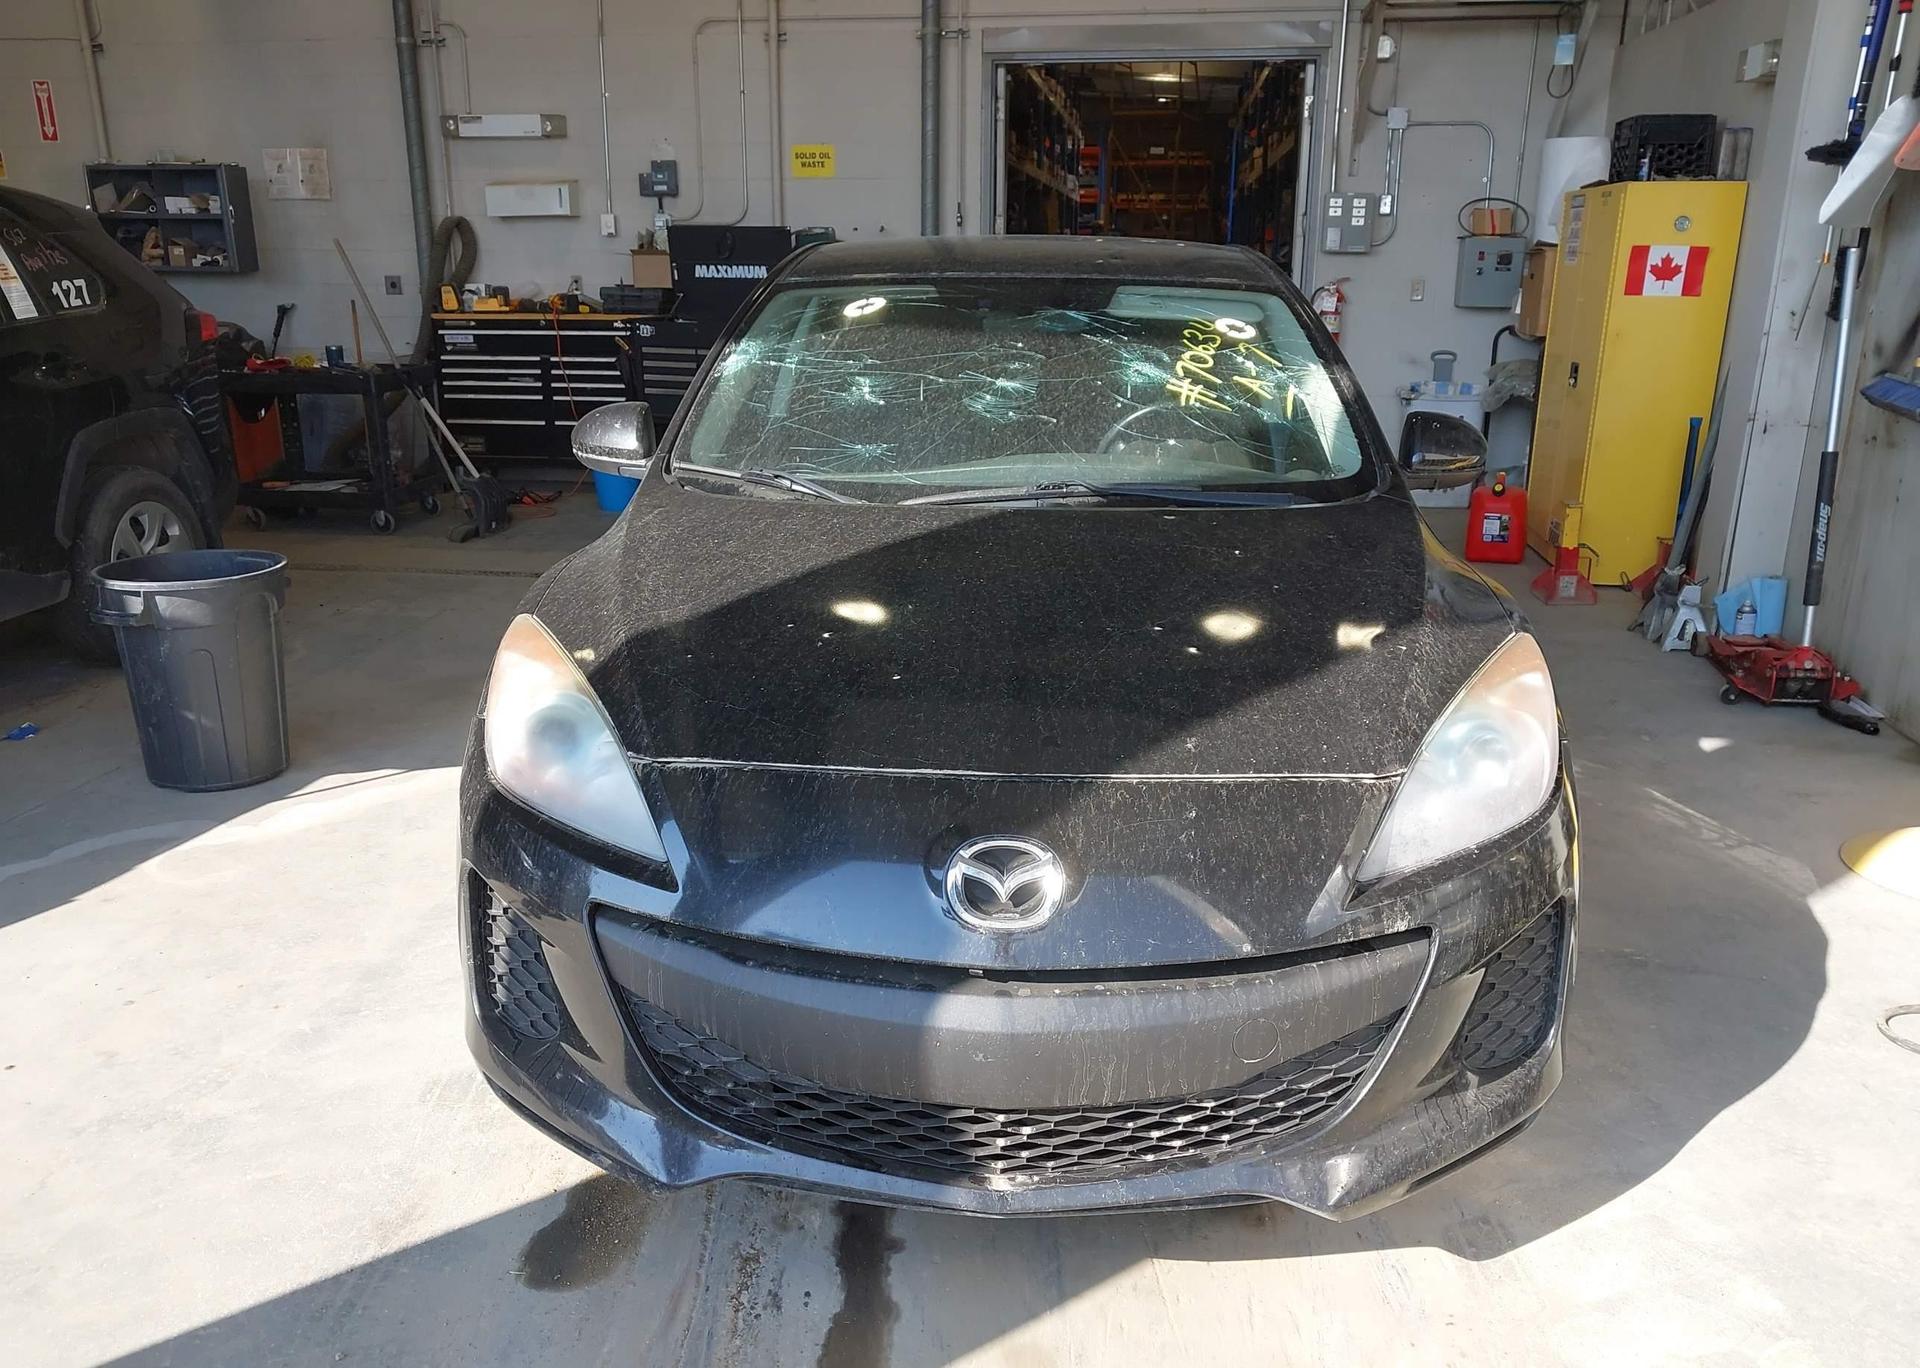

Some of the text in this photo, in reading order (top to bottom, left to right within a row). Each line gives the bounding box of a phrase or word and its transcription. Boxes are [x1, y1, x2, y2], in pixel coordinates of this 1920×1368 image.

[794, 152, 832, 160] SOLID OIL
[695, 264, 768, 279] MAXIMUM
[51, 279, 91, 308] 127
[1816, 502, 1831, 562] Snap-on
